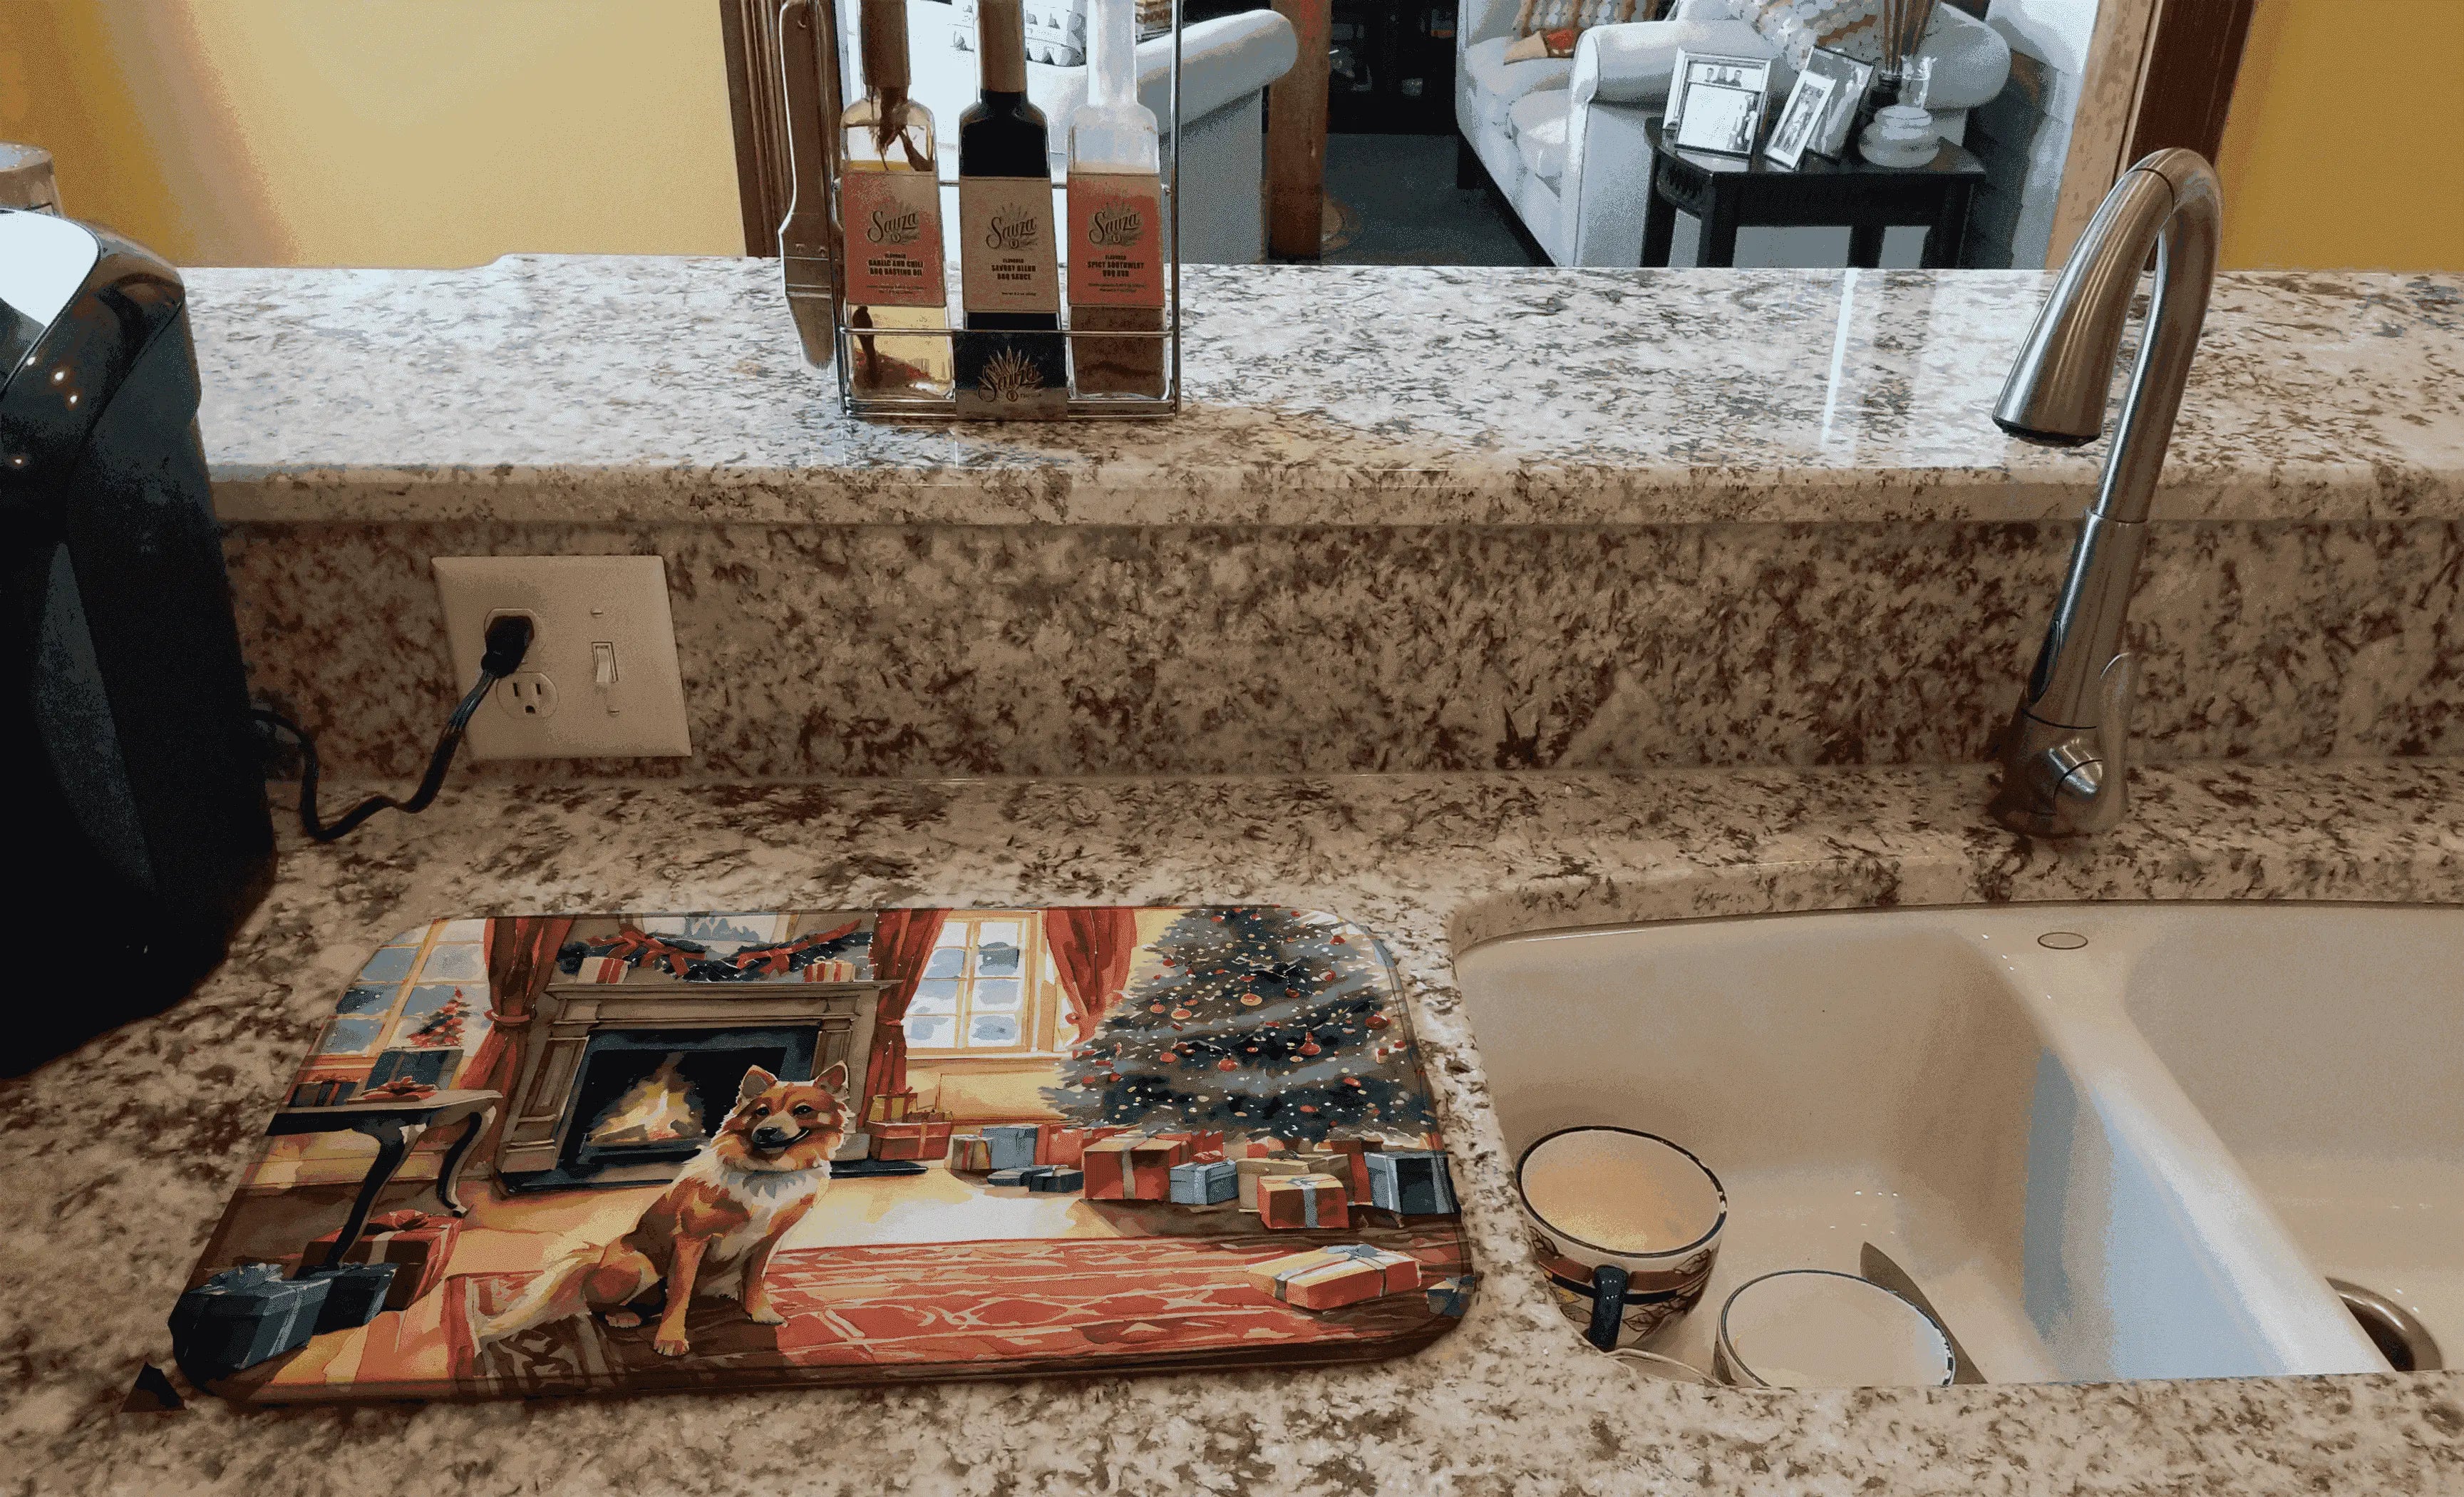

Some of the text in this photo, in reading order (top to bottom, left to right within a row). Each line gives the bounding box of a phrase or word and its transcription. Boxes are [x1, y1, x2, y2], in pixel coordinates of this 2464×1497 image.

[867, 210, 917, 242] Sauza
[986, 217, 1037, 249] Sauza
[1089, 212, 1140, 244] Sauza
